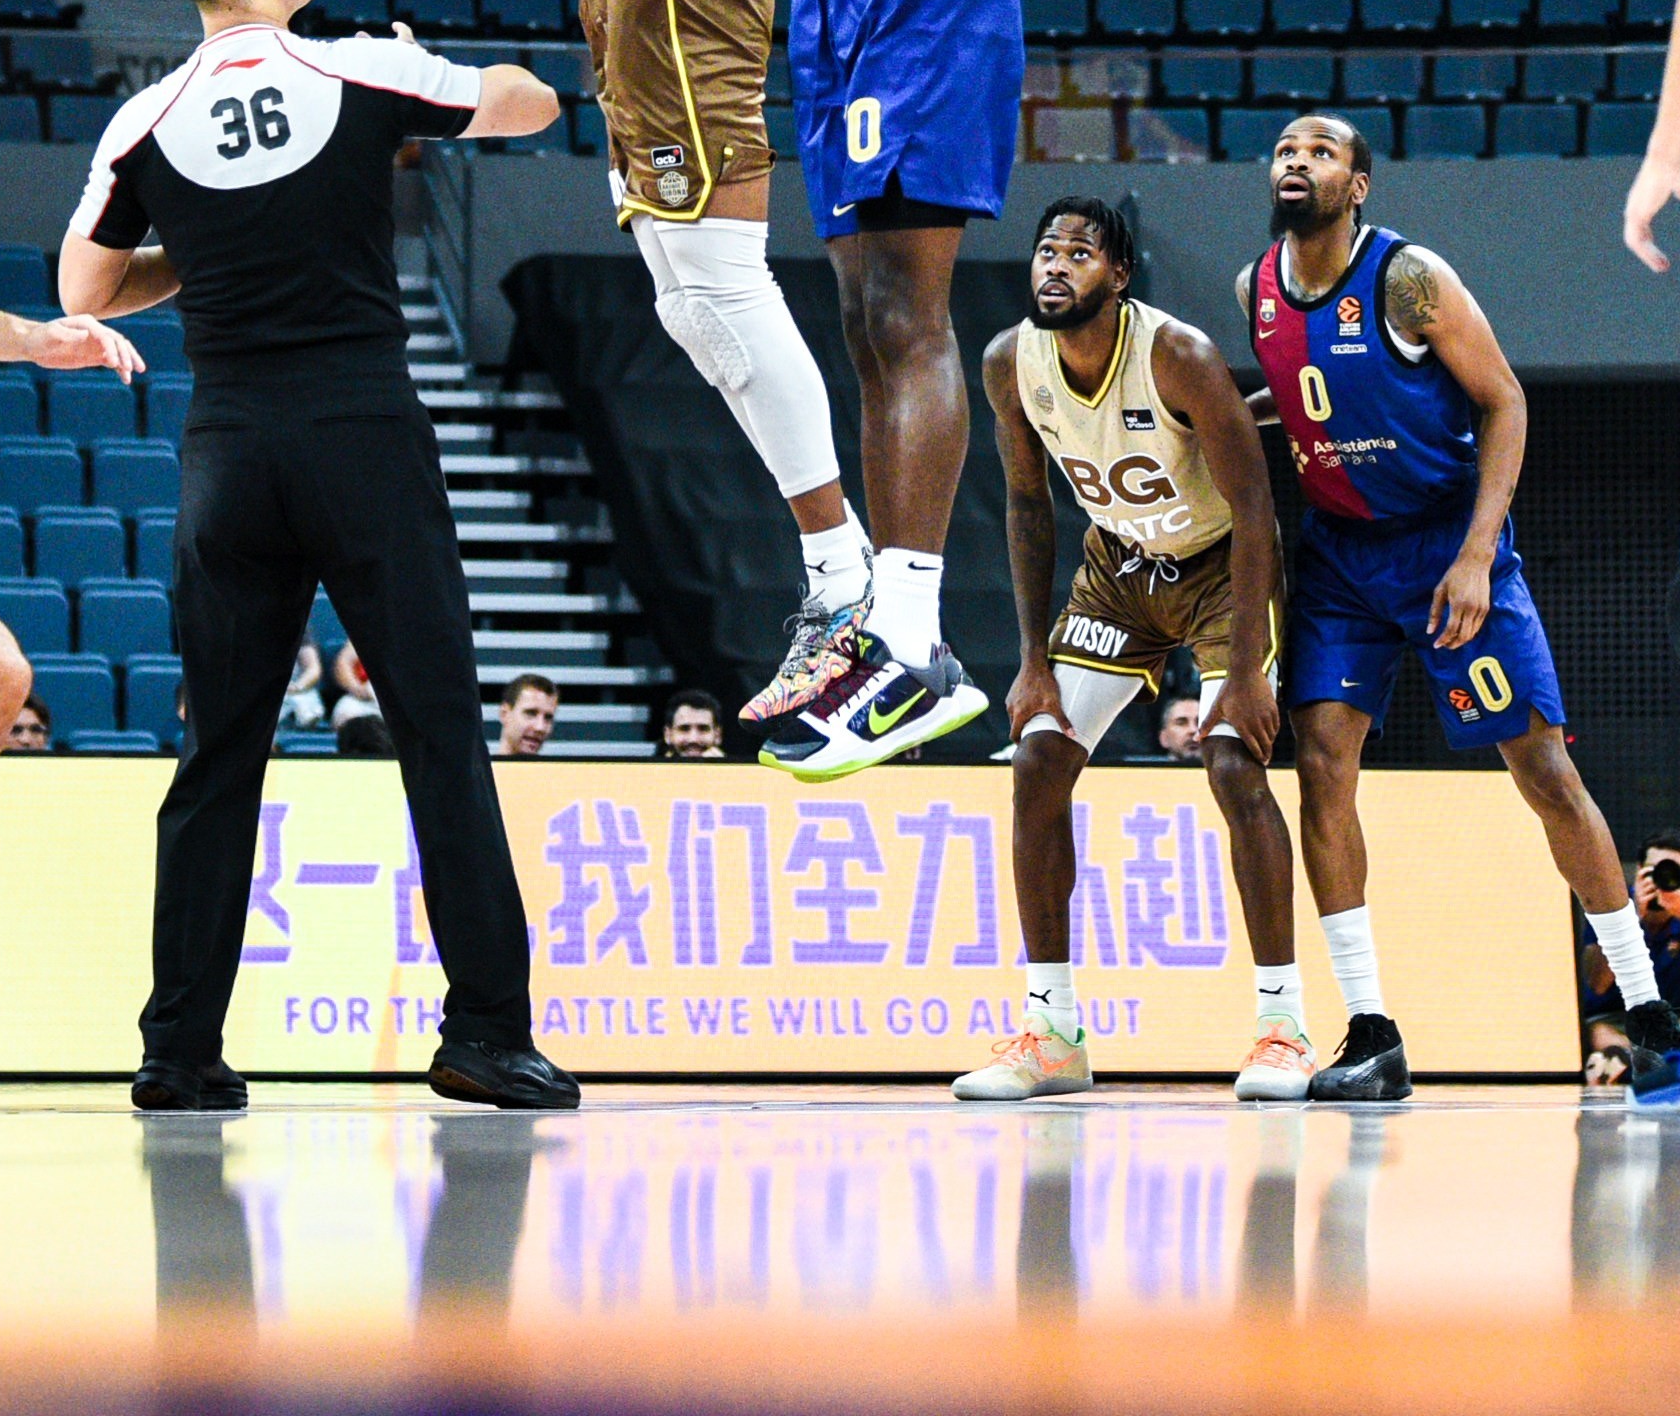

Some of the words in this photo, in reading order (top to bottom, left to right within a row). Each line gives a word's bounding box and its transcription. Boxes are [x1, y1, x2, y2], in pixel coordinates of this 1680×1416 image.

[210, 86, 291, 161] 36
[655, 154, 677, 166] acb
[1299, 366, 1333, 422] 0
[1058, 453, 1180, 509] BG
[1061, 615, 1129, 659] YOSOY
[1468, 656, 1513, 713] 0
[284, 997, 371, 1034] FOR
[390, 997, 442, 1034] TH
[531, 997, 665, 1034] ATTLE
[683, 997, 750, 1034] WE
[768, 998, 871, 1035] WILL
[886, 998, 950, 1035] GO
[968, 998, 1027, 1035] AL
[1077, 998, 1141, 1035] UT
